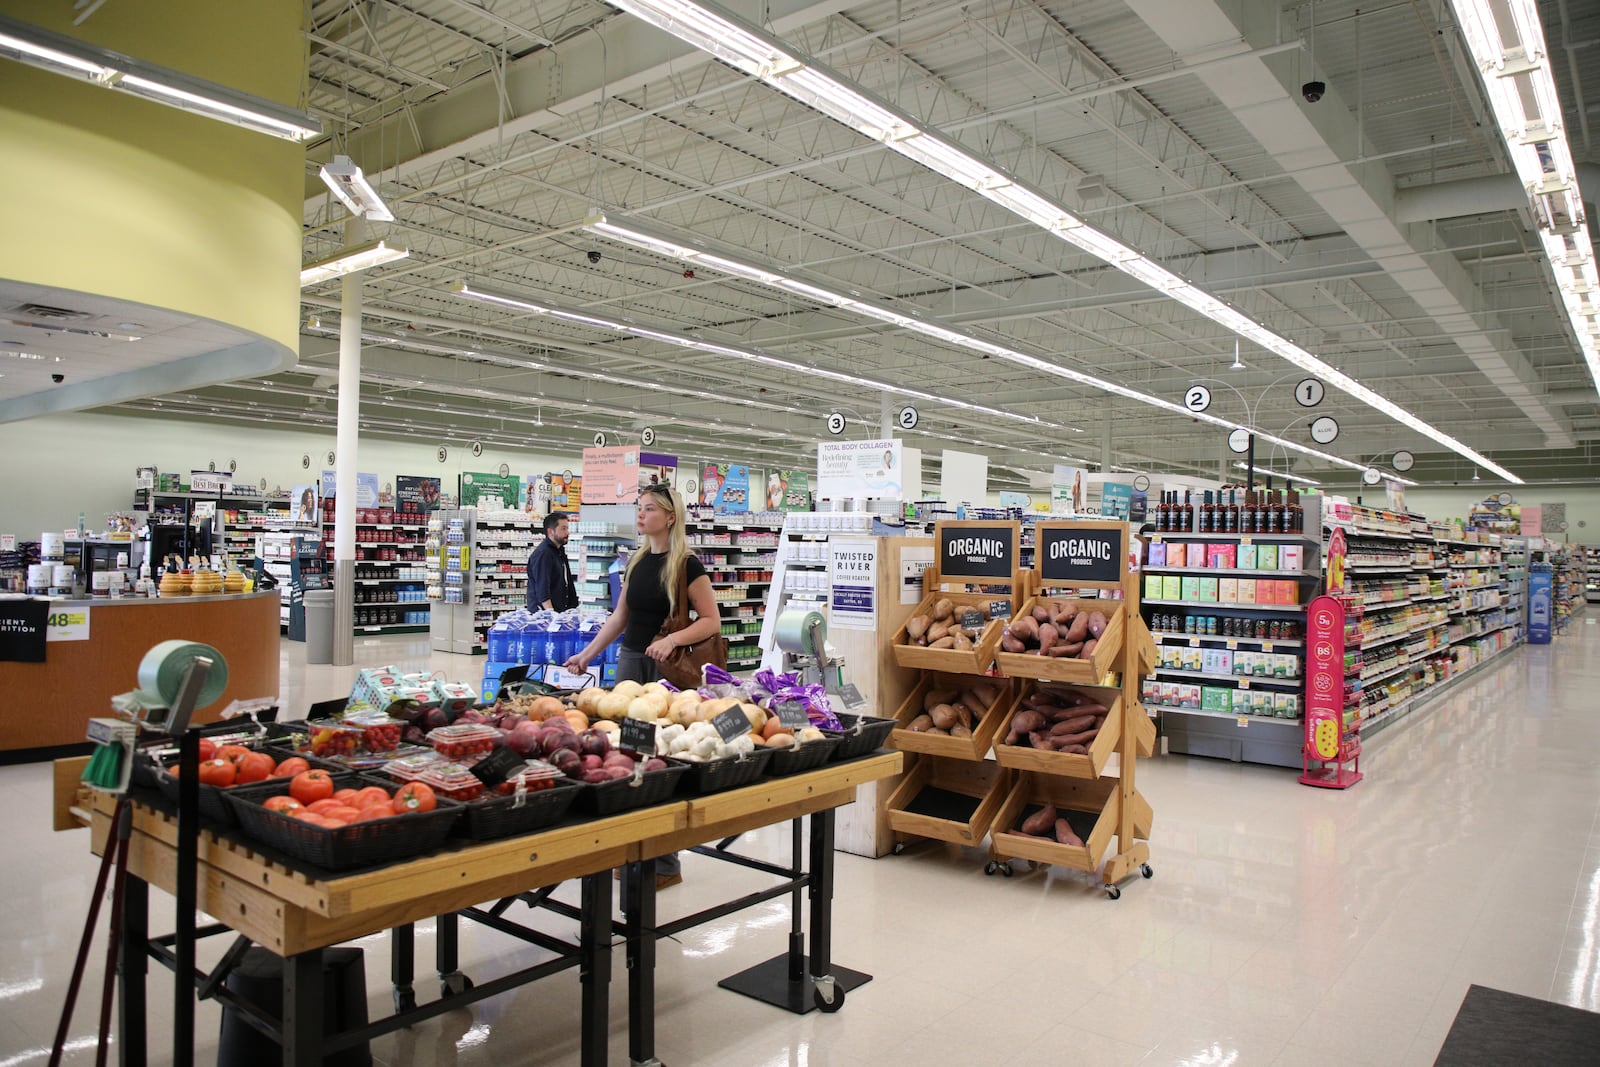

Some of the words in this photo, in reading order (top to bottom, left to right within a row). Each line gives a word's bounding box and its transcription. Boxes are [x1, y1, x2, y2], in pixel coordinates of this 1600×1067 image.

[1306, 385, 1313, 400] 1
[1190, 392, 1204, 406] 2
[903, 412, 913, 424] 2
[832, 417, 841, 430] 3
[595, 436, 604, 445] 4
[644, 431, 652, 441] 3
[474, 445, 481, 454] 4
[859, 441, 893, 450] COLLAGEN
[439, 451, 445, 459] 5
[948, 537, 1004, 559] ORGANIC
[1049, 538, 1111, 561] ORGANIC
[834, 552, 874, 562] TWISTED
[967, 556, 987, 564] PRODUCE
[837, 562, 870, 572] RIVER
[1070, 558, 1093, 567] PRODUCE
[851, 574, 870, 582] ROASTER
